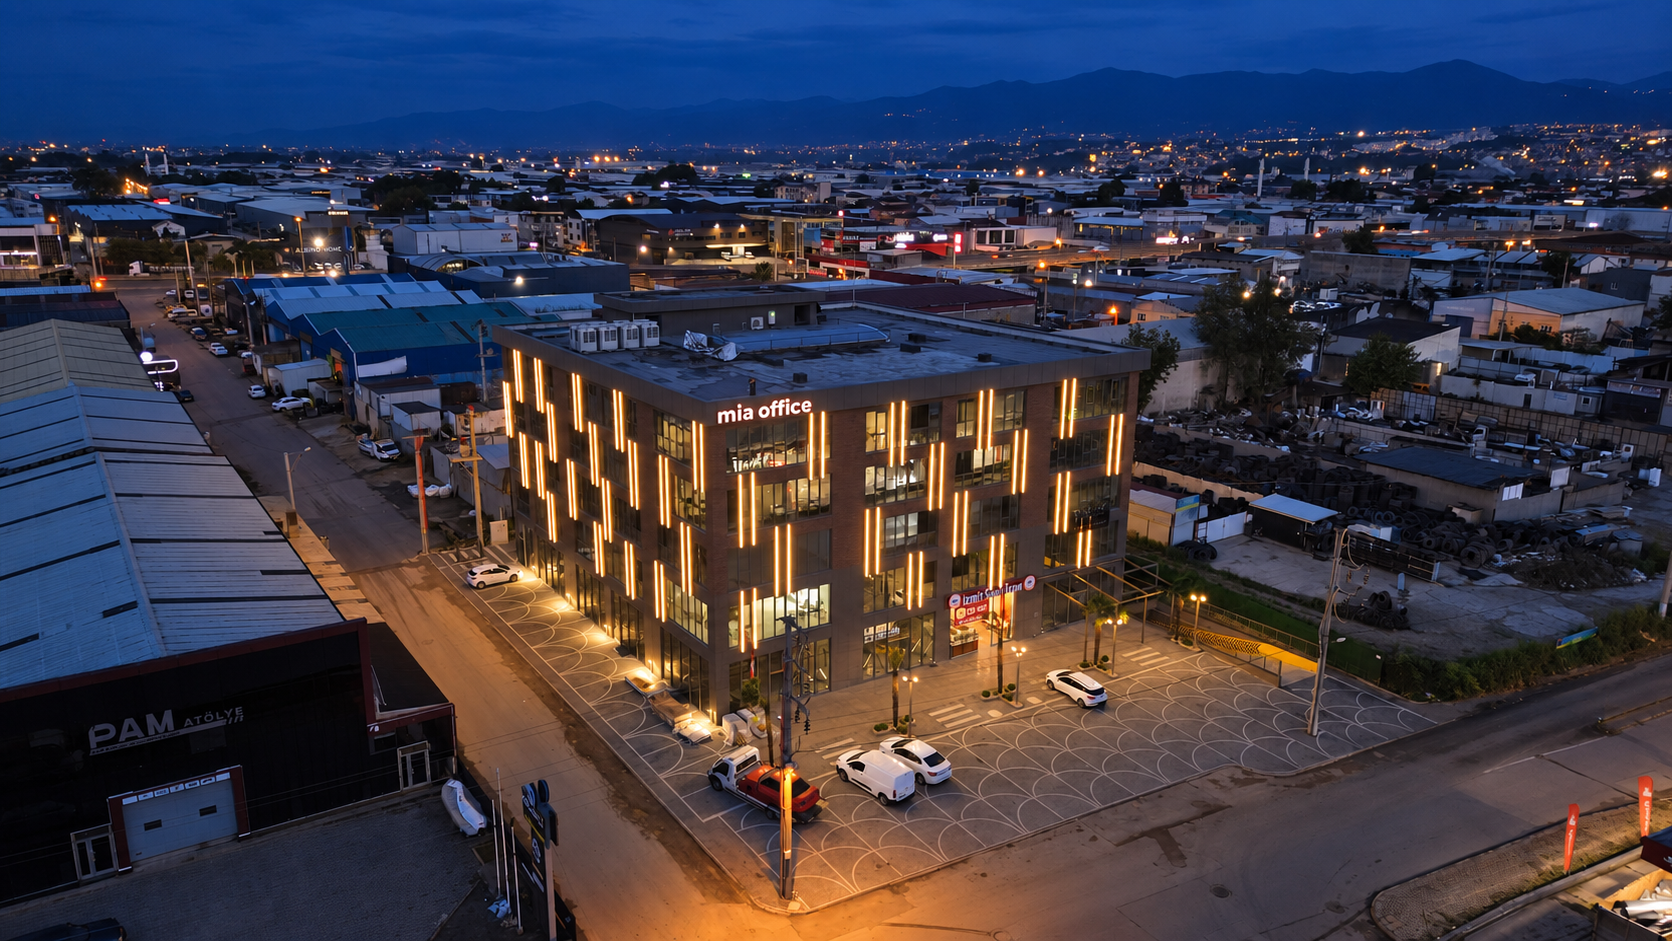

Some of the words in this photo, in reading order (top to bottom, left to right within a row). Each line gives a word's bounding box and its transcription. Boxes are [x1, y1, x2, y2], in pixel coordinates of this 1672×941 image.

[717, 403, 754, 424] mia
[758, 398, 813, 419] office
[87, 709, 175, 749] PAM
[183, 706, 244, 728] ATÖLYE
